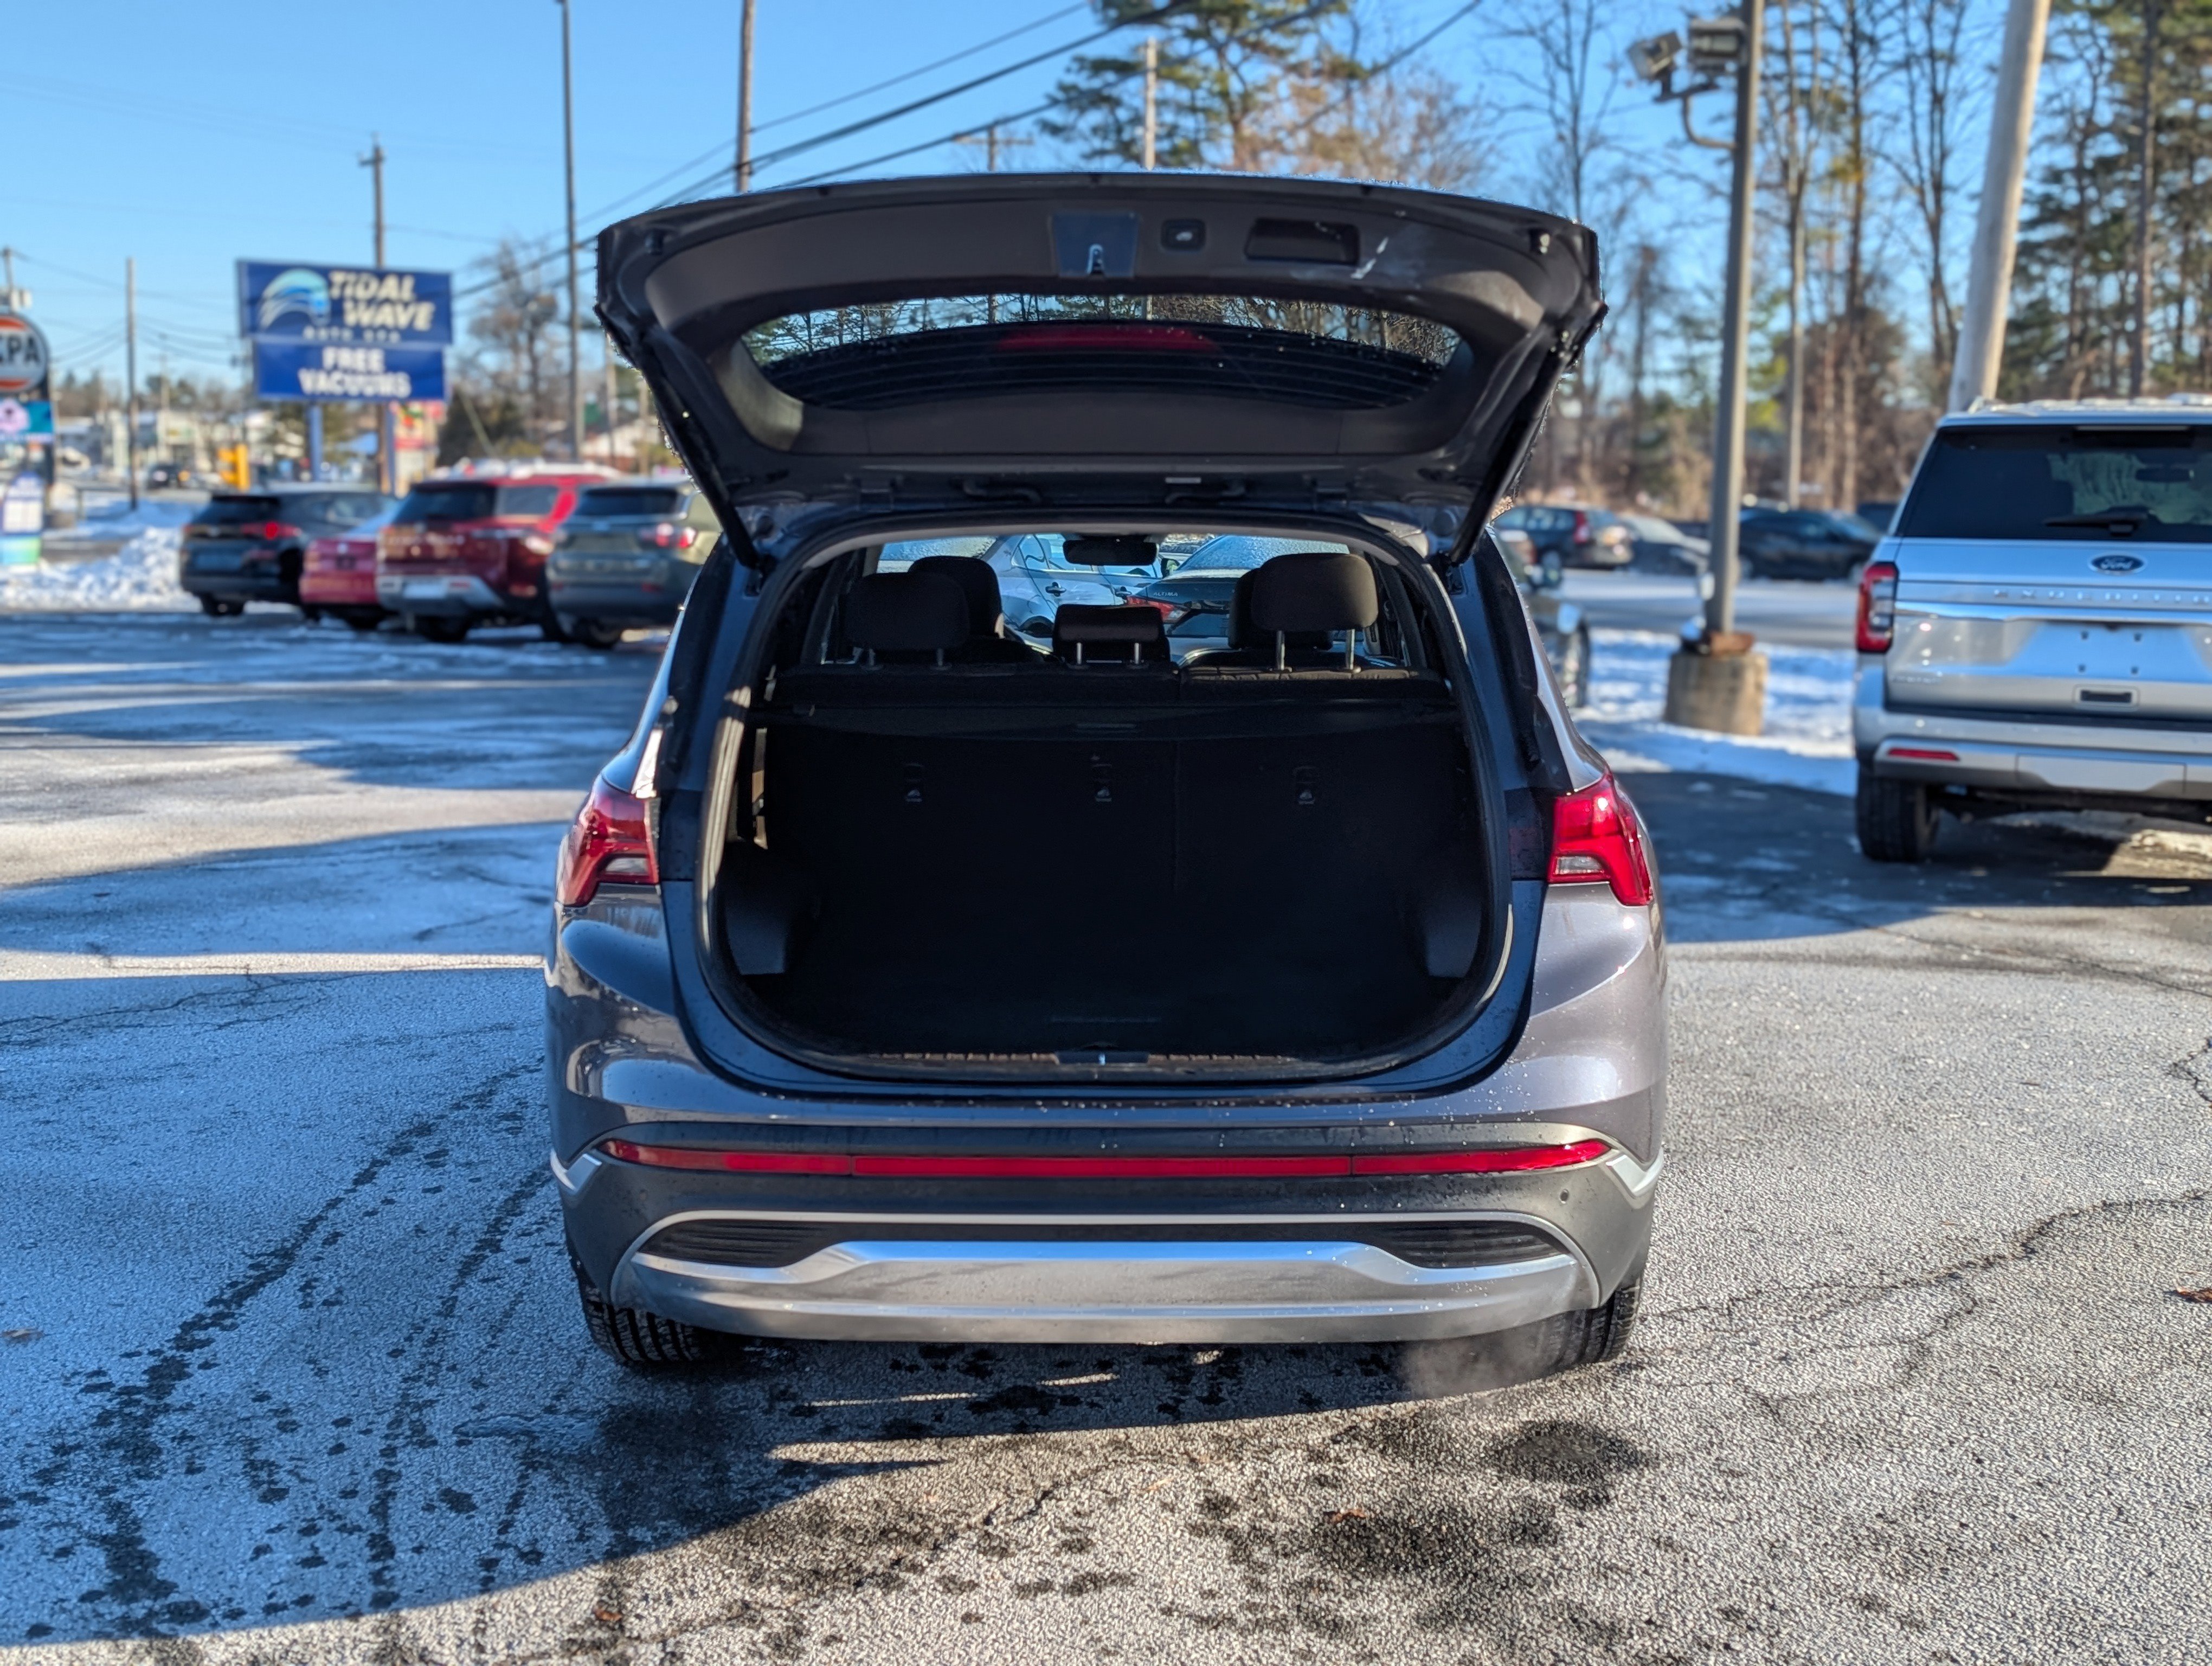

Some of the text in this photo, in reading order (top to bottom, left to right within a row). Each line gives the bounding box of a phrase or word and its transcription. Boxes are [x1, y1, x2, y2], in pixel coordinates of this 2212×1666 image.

[329, 271, 416, 302] TIDAL
[343, 300, 435, 331] WAVE
[0, 334, 40, 366] PA
[323, 346, 385, 373] FREE
